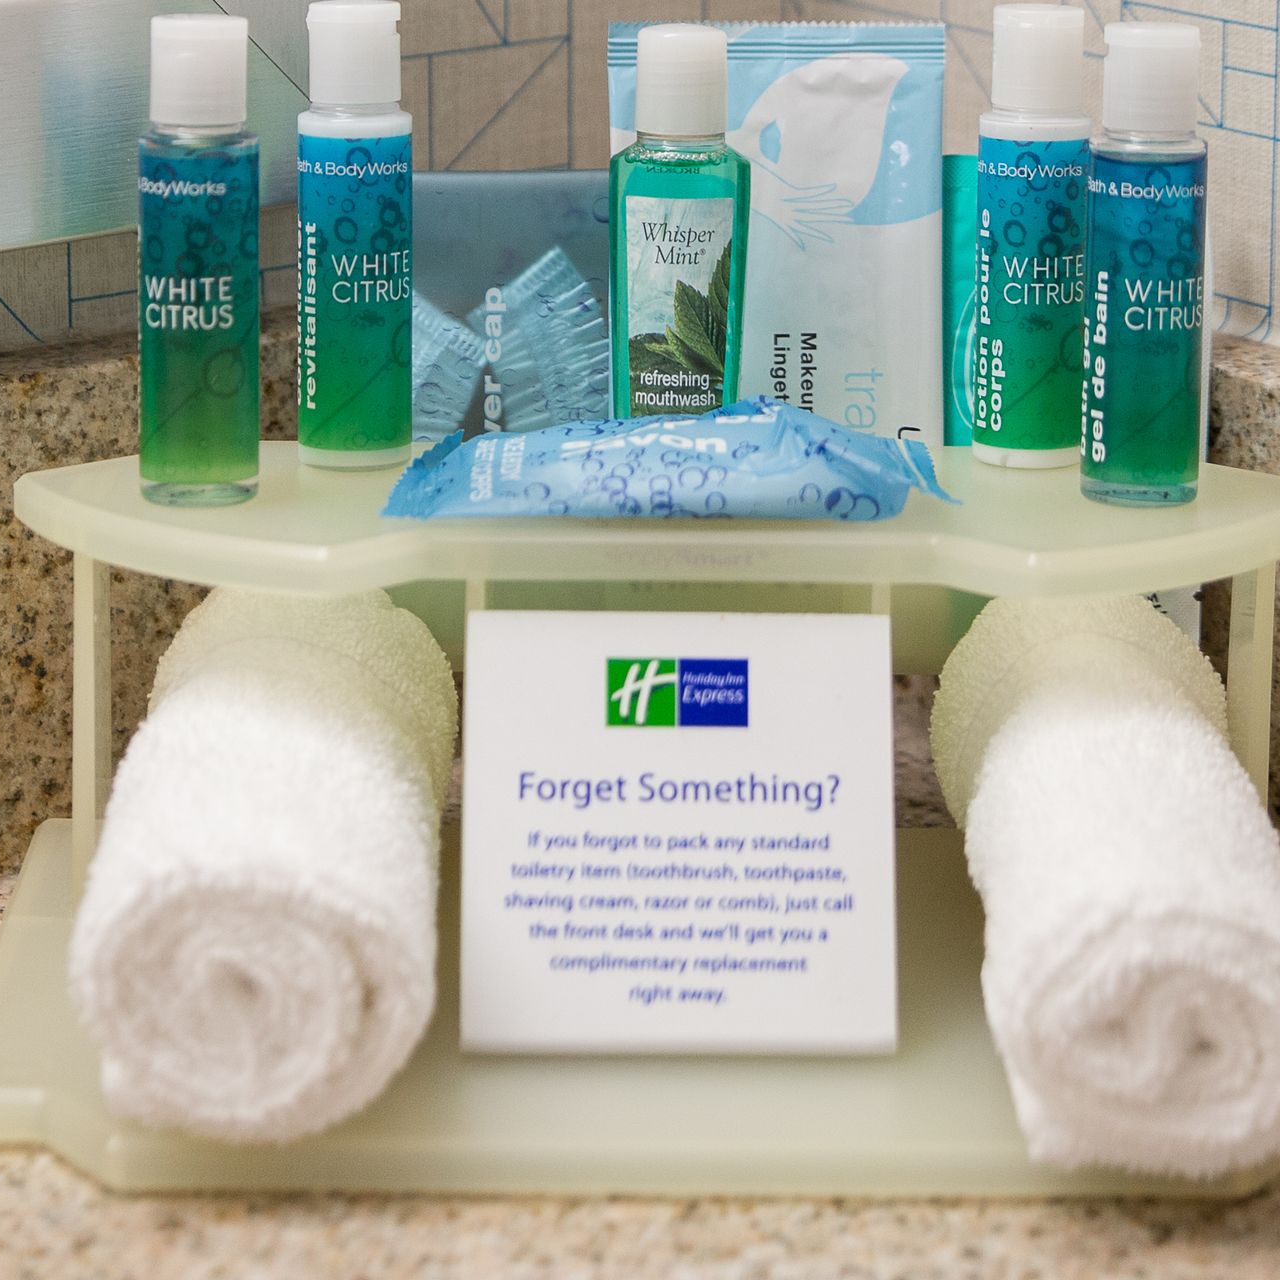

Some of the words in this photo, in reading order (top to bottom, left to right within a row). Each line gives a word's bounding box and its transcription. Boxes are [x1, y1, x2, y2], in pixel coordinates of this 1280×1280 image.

[314, 162, 323, 174] &
[988, 162, 996, 175] &
[1108, 181, 1118, 196] &
[642, 222, 715, 247] Whisper
[979, 208, 990, 238] le
[331, 250, 410, 277] WHITE
[1003, 254, 1084, 279] WHITE
[145, 274, 233, 302] WHITE
[332, 276, 410, 304] CITRUS
[979, 248, 991, 325] pour
[1003, 280, 1084, 305] CITRUS
[1124, 276, 1203, 304] WHITE
[145, 303, 234, 330] CITRUS
[305, 221, 317, 410] revitalisant
[1093, 270, 1109, 346] bain
[1124, 304, 1202, 331] CITRUS
[485, 287, 507, 362] cap
[640, 370, 709, 390] refreshing
[770, 333, 790, 404] Linget
[1092, 355, 1106, 399] de
[976, 336, 989, 429] lotion
[990, 338, 1006, 432] corps
[635, 390, 716, 407] mouthwash
[845, 368, 883, 431] tra
[1091, 409, 1106, 463] gel
[682, 685, 744, 707] Express
[519, 771, 627, 809] Forget
[638, 772, 840, 811] Something?
[527, 830, 541, 848] If
[545, 835, 577, 852] you
[583, 831, 638, 852] forgot
[644, 834, 662, 848] to
[667, 834, 708, 852] pack
[714, 836, 745, 853] any
[752, 833, 829, 850] standard
[511, 862, 575, 881] toiletry
[581, 862, 621, 878] item
[627, 862, 738, 881] (toothbrush,
[744, 863, 847, 883] toothpaste,
[504, 891, 573, 911] shaving
[579, 895, 638, 910] cream,
[644, 895, 689, 909] razor
[694, 896, 713, 910] or
[785, 893, 818, 914] just
[824, 893, 853, 911] call
[529, 922, 558, 938] the
[564, 921, 608, 938] front
[613, 922, 653, 939] desk
[660, 924, 693, 939] and
[745, 926, 774, 944] get
[780, 928, 812, 945] you
[819, 929, 828, 941] a
[549, 952, 688, 974] complimentary
[693, 954, 807, 972] replacement
[629, 985, 671, 1006] right
[678, 988, 727, 1006] away.
